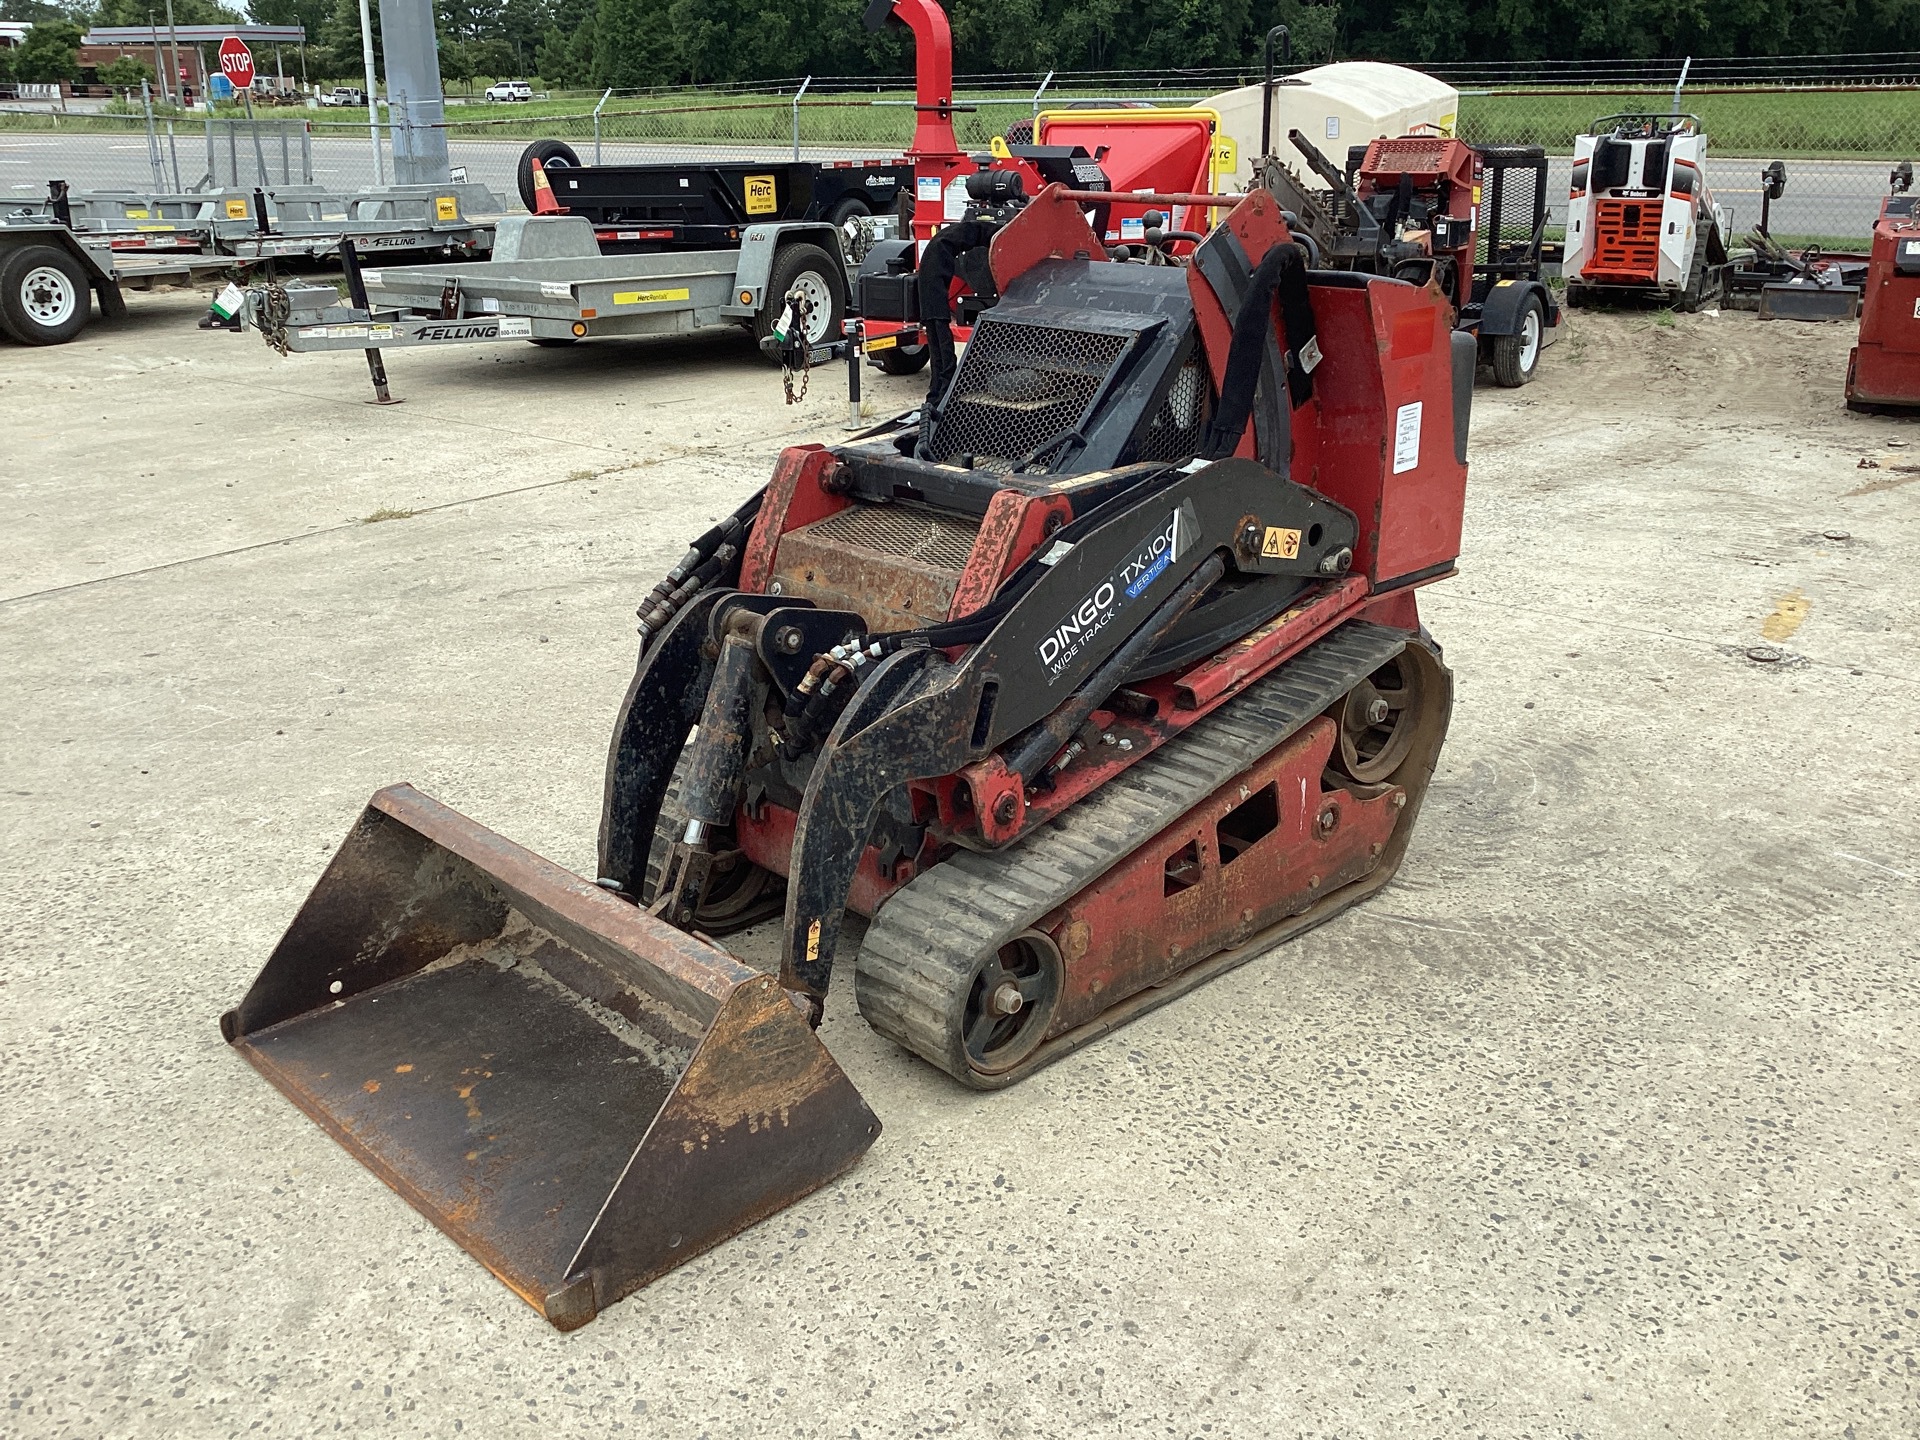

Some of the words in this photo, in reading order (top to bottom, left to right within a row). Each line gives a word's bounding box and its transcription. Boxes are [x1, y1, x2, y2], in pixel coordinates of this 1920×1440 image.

[222, 53, 250, 72] STOP
[750, 185, 772, 196] Herc
[229, 207, 244, 215] Herc
[372, 237, 416, 247] FELLING
[411, 324, 499, 340] FELLING
[1129, 550, 1172, 595] VERTICA
[1038, 582, 1115, 665] DINGO
[1050, 647, 1079, 674] WIDE
[1078, 608, 1115, 646] TRACK
